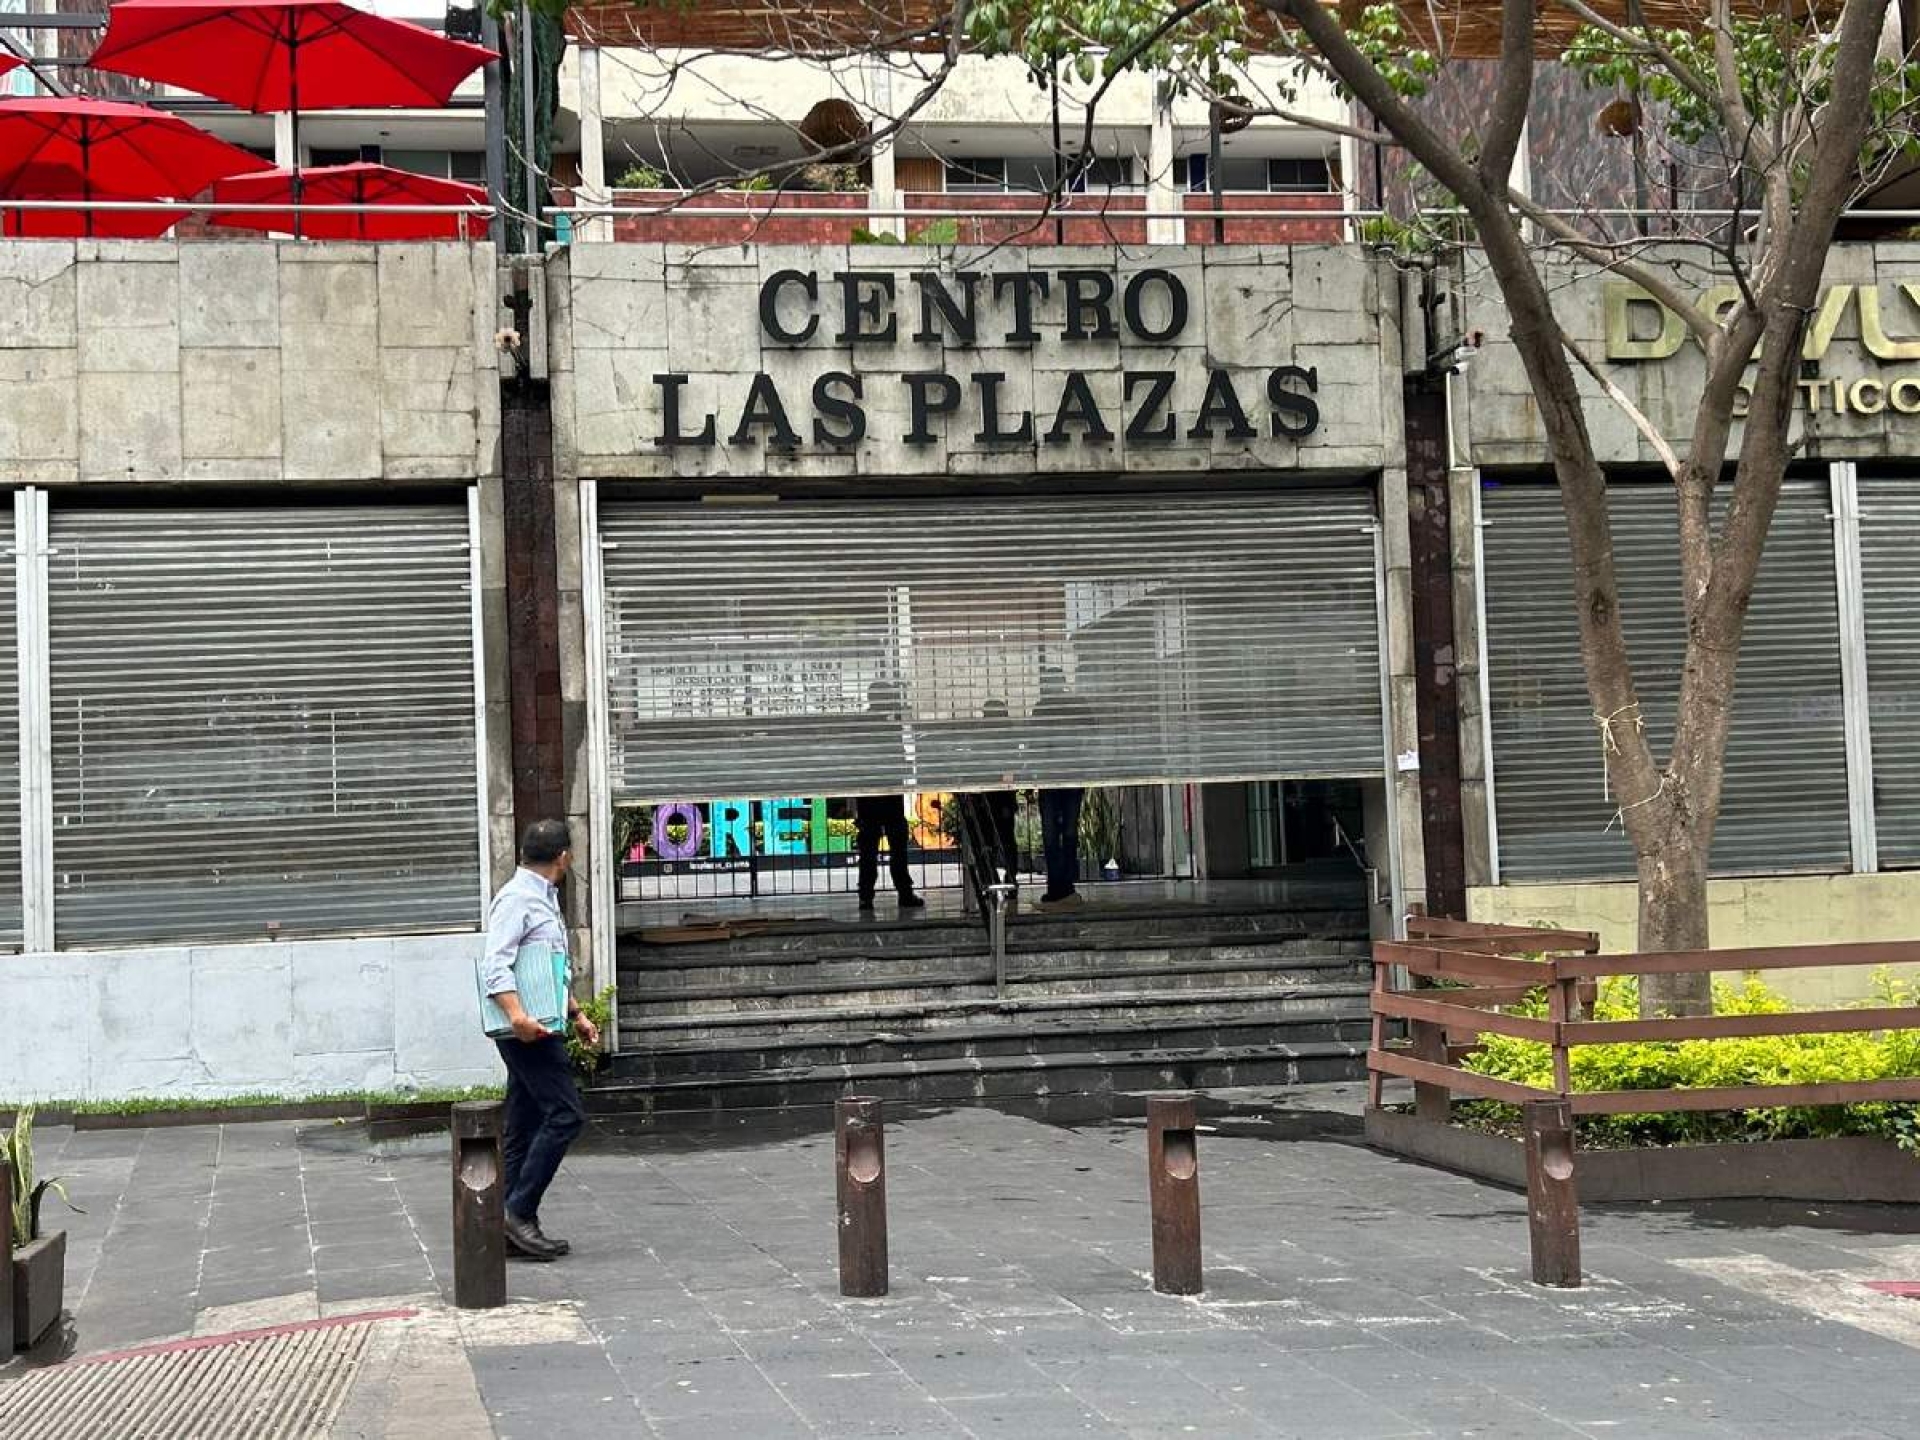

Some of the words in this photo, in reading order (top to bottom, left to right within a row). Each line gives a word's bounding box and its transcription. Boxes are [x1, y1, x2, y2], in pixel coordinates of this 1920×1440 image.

[759, 268, 1188, 344] CENTRO
[653, 371, 866, 447] LAS
[901, 364, 1320, 445] PLAZAS
